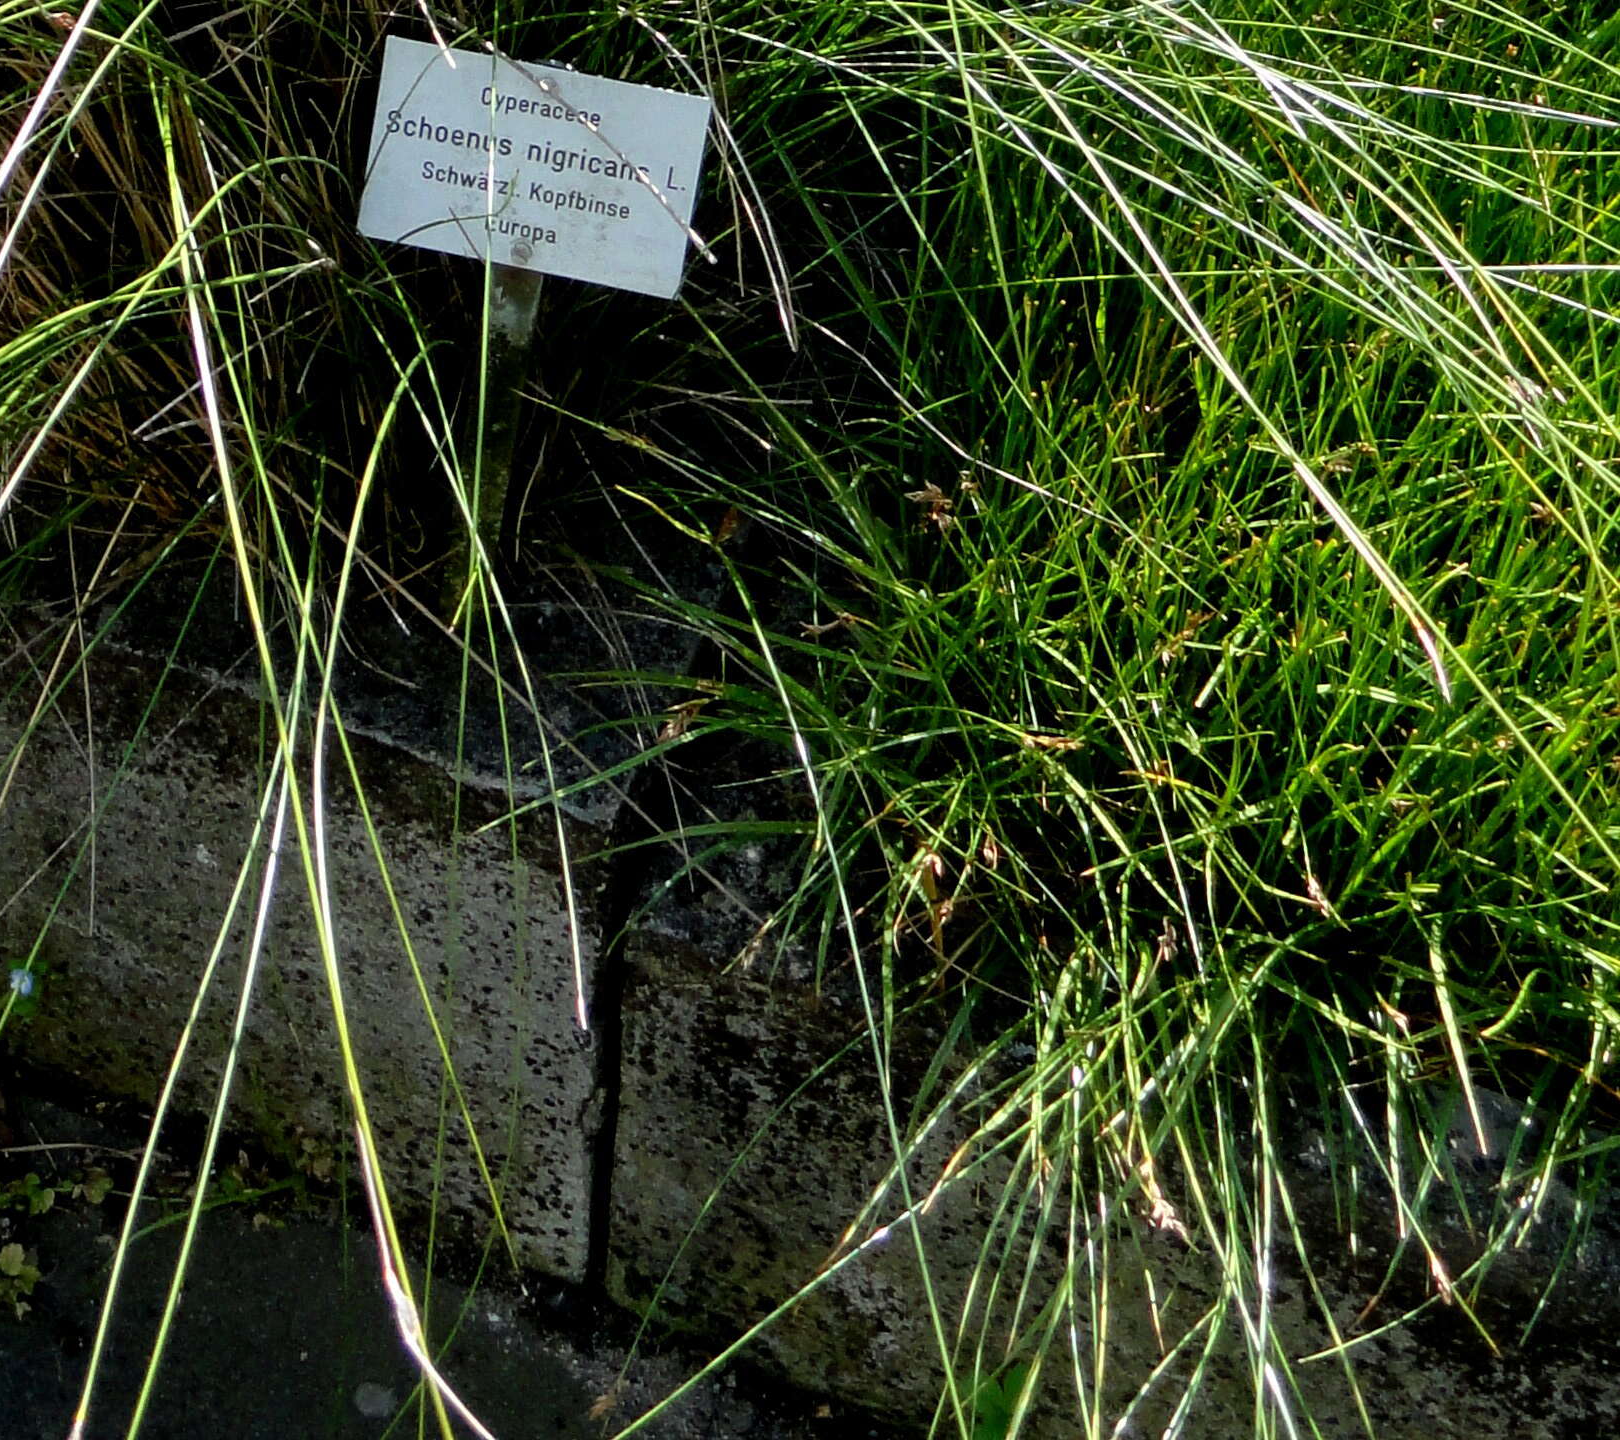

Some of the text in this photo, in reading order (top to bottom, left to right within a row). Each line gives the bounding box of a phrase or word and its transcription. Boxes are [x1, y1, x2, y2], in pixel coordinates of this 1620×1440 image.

[481, 86, 602, 127] Cyperaceae
[386, 110, 513, 156] Schoenus
[666, 165, 686, 192] L.
[421, 160, 631, 220] Schwäz. Kopfbinse
